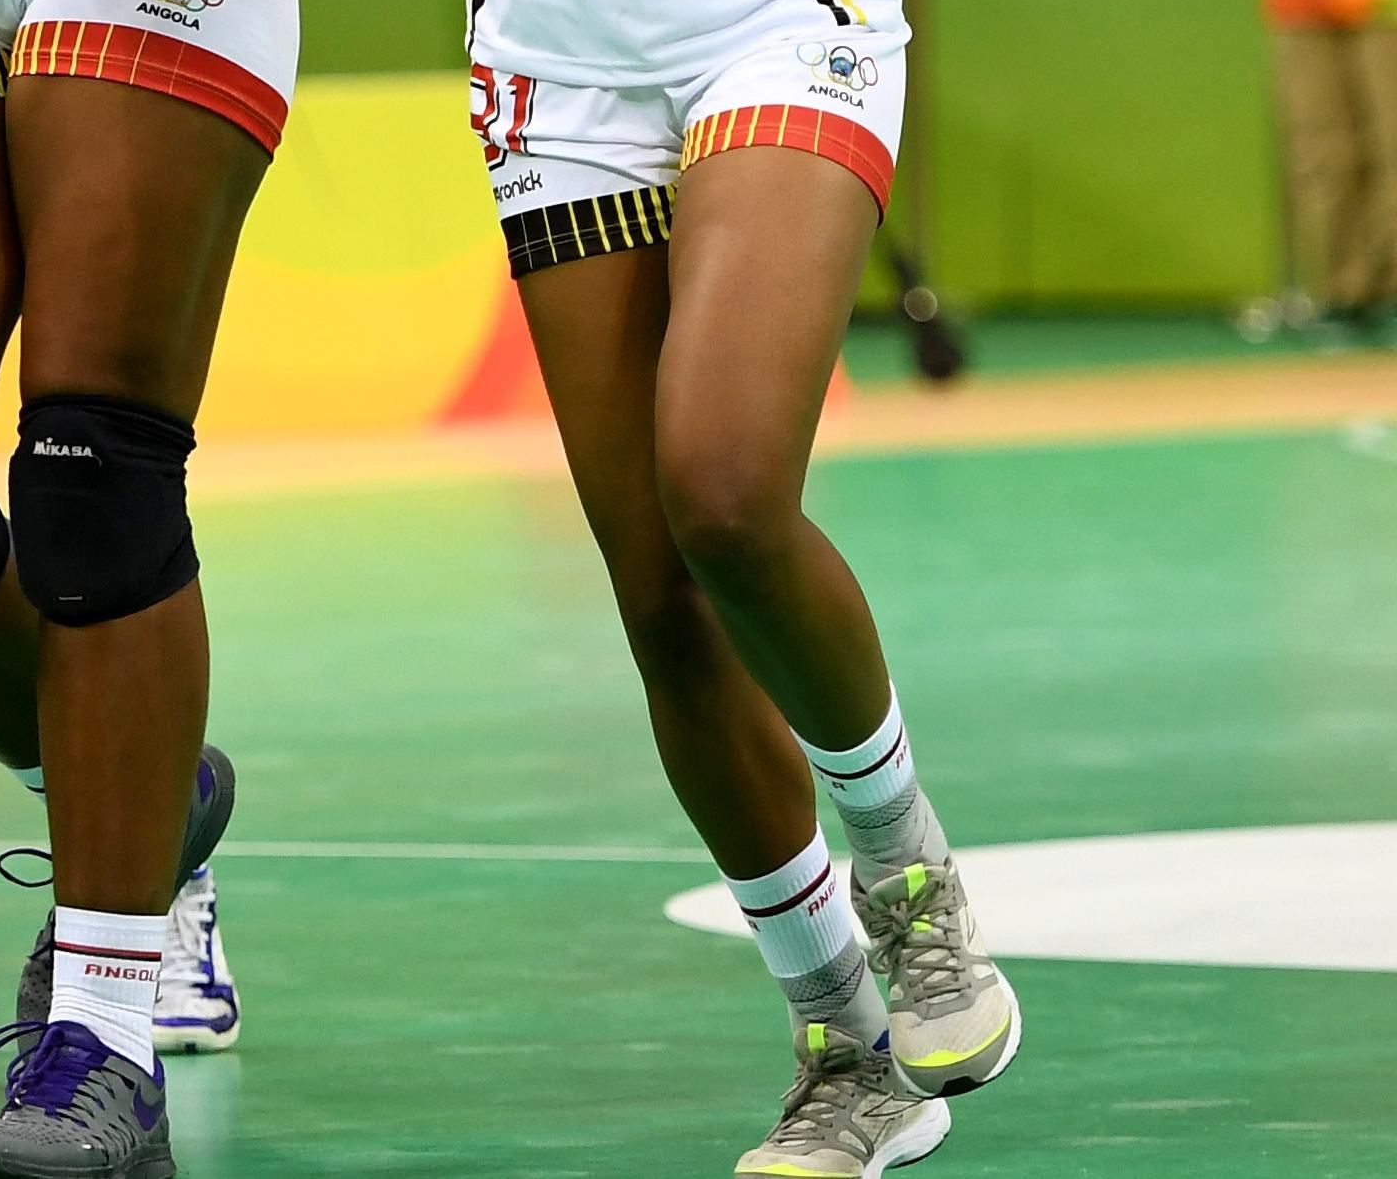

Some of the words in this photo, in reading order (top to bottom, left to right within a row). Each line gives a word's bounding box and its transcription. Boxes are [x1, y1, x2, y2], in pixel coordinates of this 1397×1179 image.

[136, 2, 201, 32] ANGOLA
[807, 83, 865, 110] ANGOLA
[84, 963, 157, 982] ANGOL
